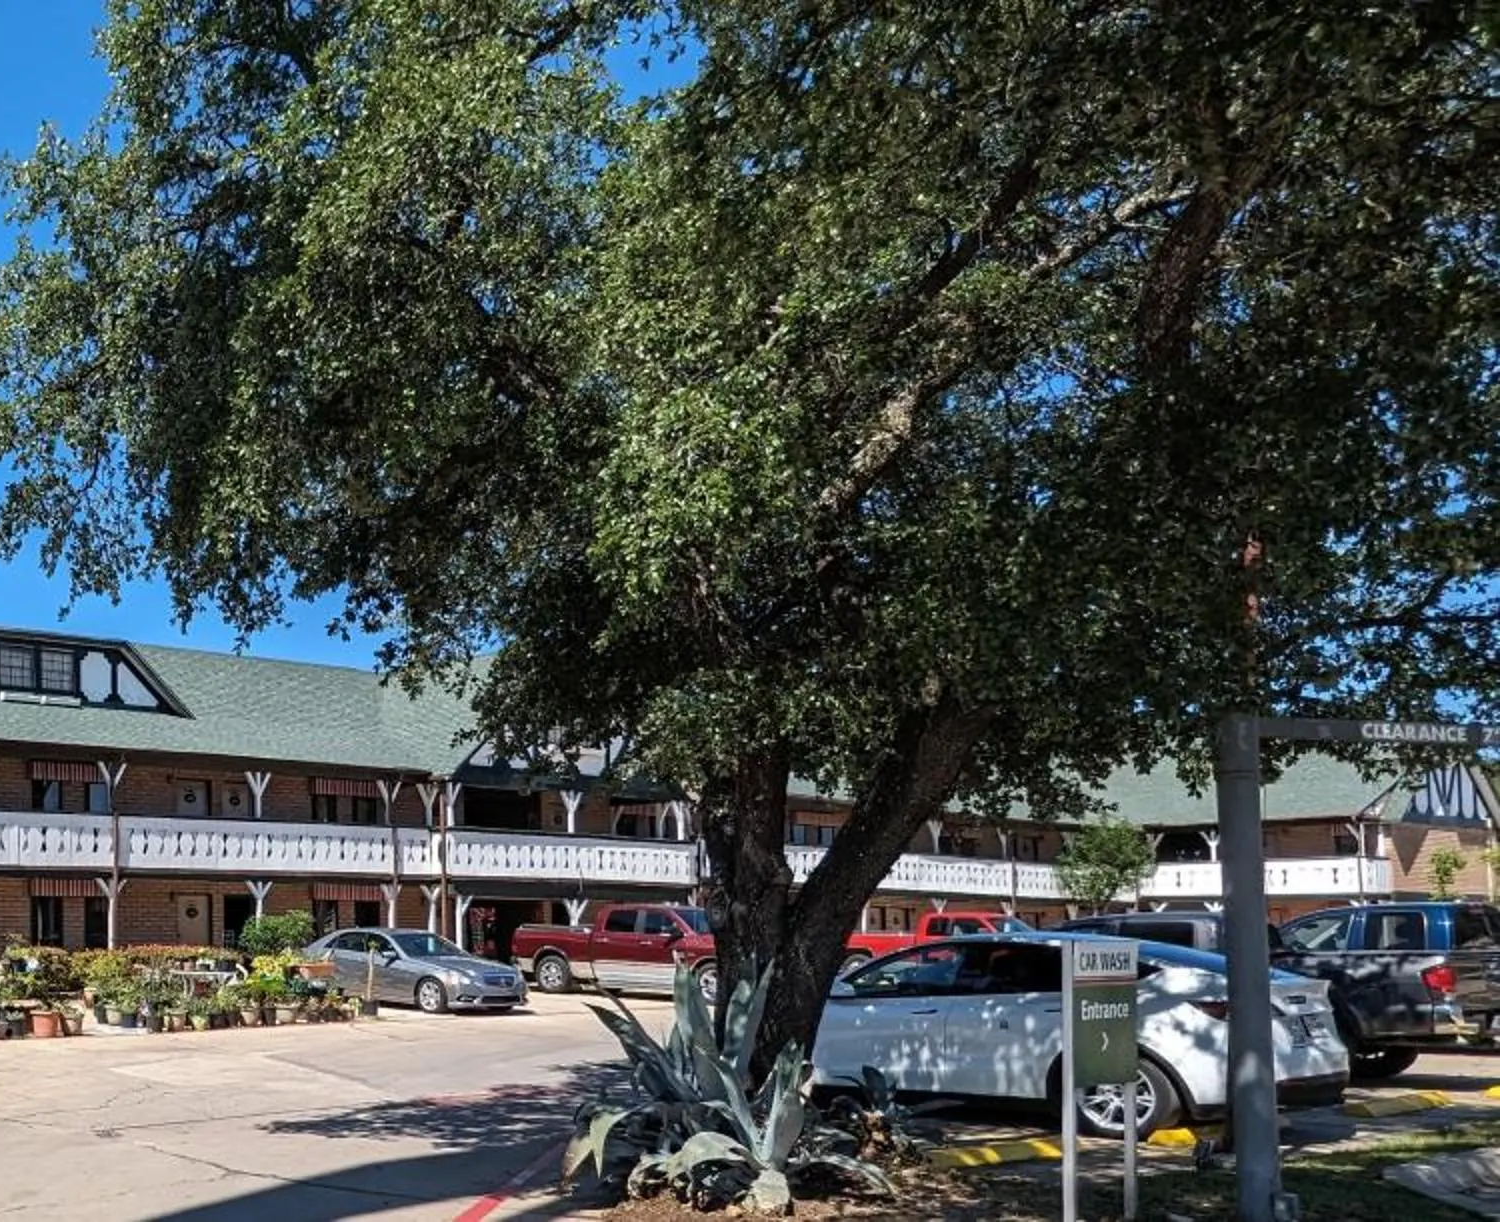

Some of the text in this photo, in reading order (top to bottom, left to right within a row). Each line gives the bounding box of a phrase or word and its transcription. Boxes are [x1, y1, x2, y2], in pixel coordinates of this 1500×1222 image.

[1361, 722, 1468, 742] CLEARANCE
[1080, 951, 1131, 971] CAR WASH
[1081, 999, 1130, 1021] Entrance
